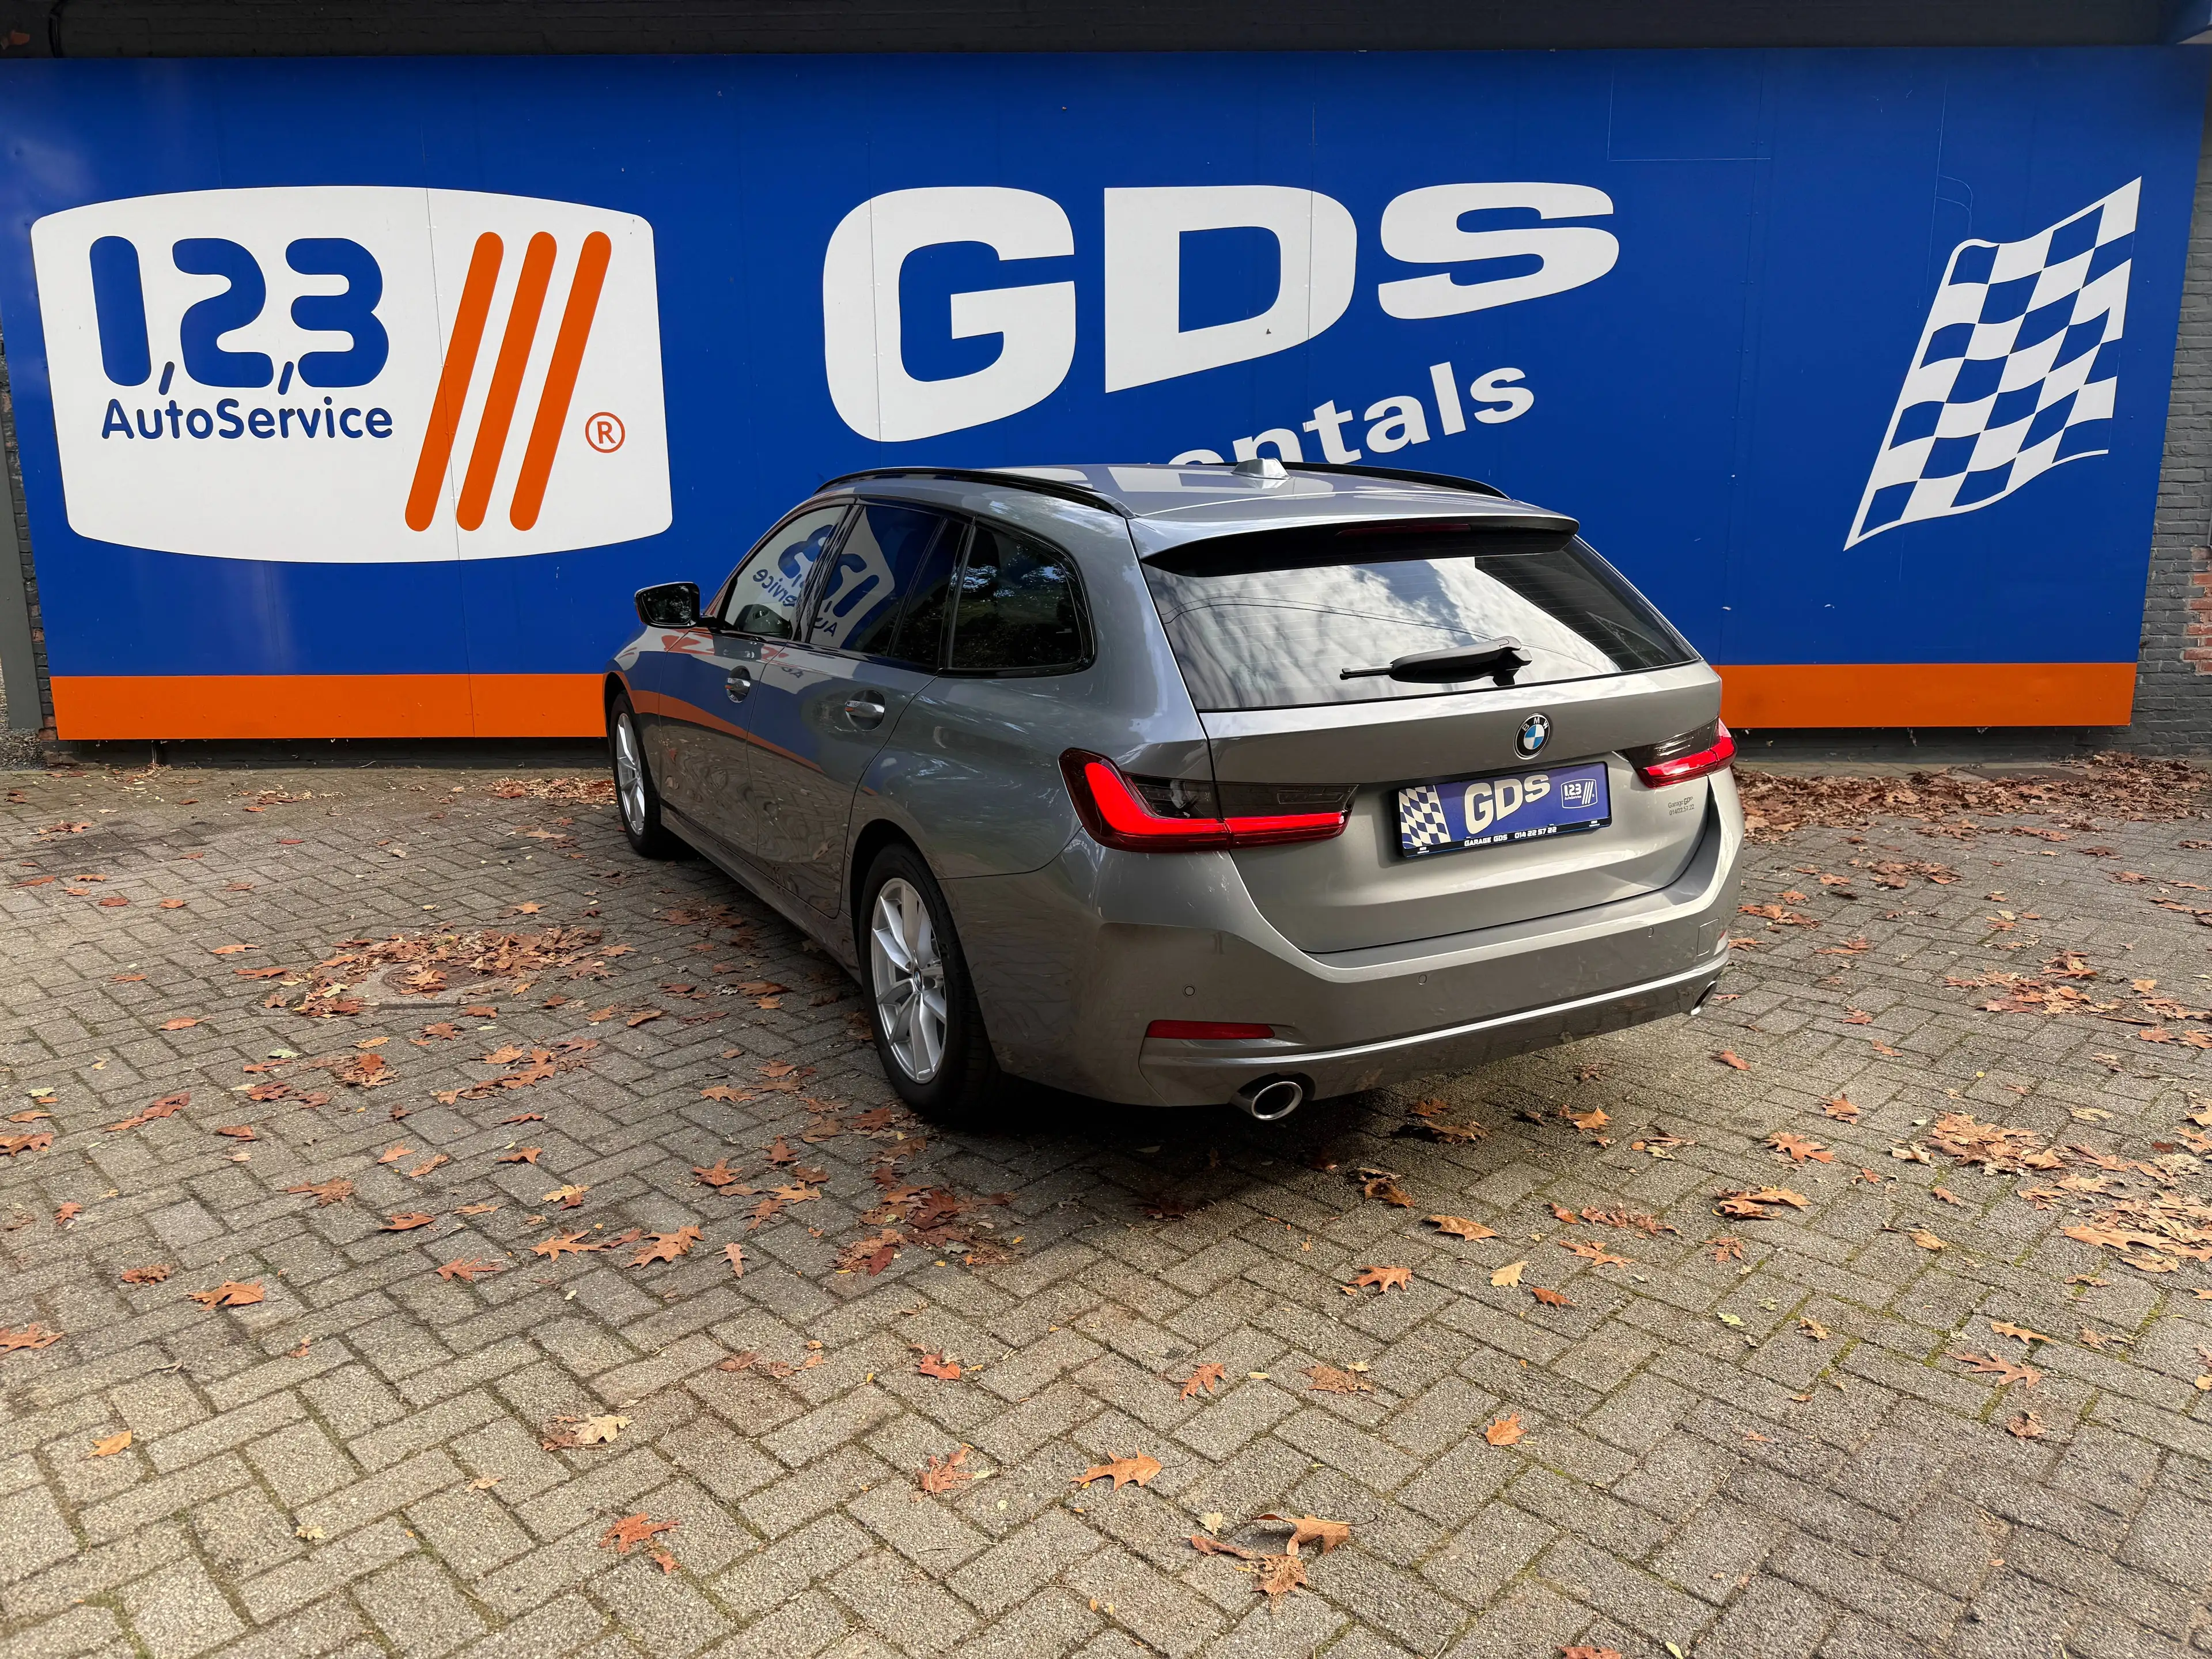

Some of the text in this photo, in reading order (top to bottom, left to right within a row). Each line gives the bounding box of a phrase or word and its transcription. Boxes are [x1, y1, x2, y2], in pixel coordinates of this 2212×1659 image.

[823, 182, 1619, 442] GDS
[101, 397, 392, 440] AutoService
[1168, 361, 1535, 465] ntals
[1522, 717, 1548, 732] BMW
[1464, 774, 1551, 835] GDS
[1464, 837, 1492, 847] GARAGE
[1493, 834, 1508, 842] GDS
[1514, 831, 1527, 839] 014
